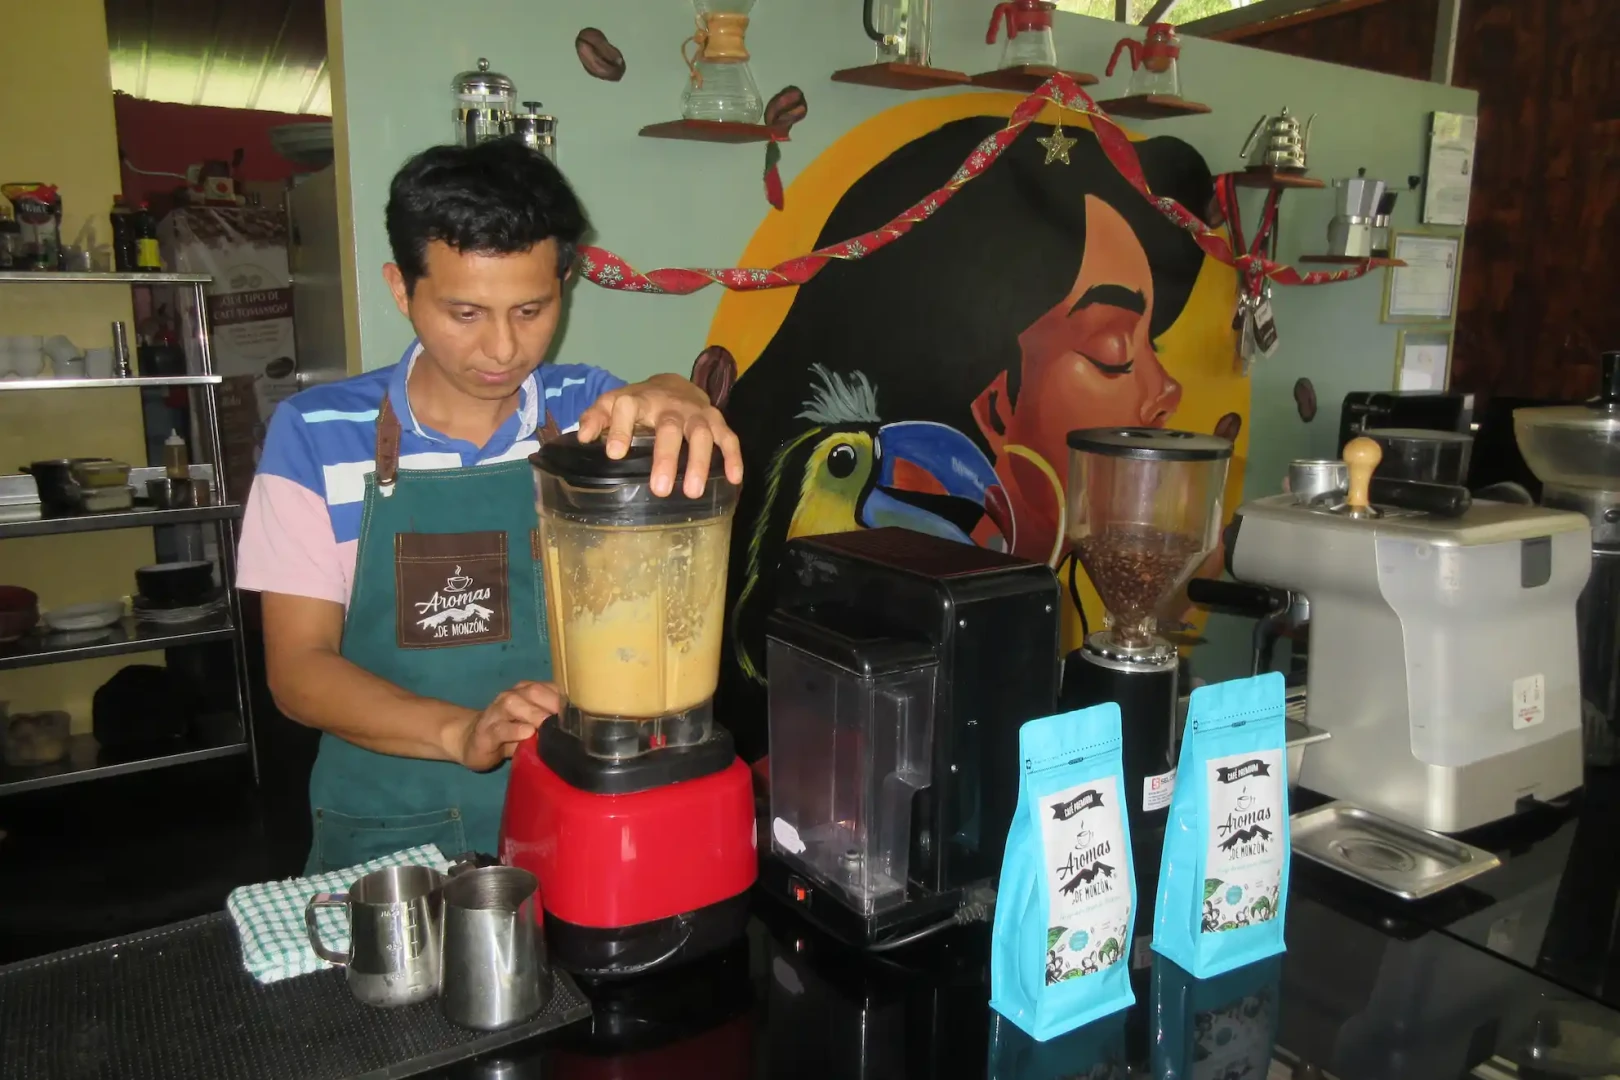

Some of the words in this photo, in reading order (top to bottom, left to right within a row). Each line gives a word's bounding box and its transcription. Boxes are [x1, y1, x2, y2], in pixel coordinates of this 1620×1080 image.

[414, 587, 491, 615] Aromas
[438, 625, 448, 638] DE
[452, 618, 484, 636] MONZÓN
[1227, 768, 1238, 782] CAFÉ
[1238, 763, 1259, 779] PREMIUM
[1064, 802, 1073, 818] CAFÉ
[1073, 794, 1094, 813] PREMIUM
[1217, 807, 1271, 837] Aromas
[1056, 840, 1111, 880] Aromas
[1232, 847, 1239, 859] DE
[1240, 842, 1264, 857] MONZÓN
[1075, 889, 1083, 904] DE
[1085, 880, 1109, 901] MONZÓN
